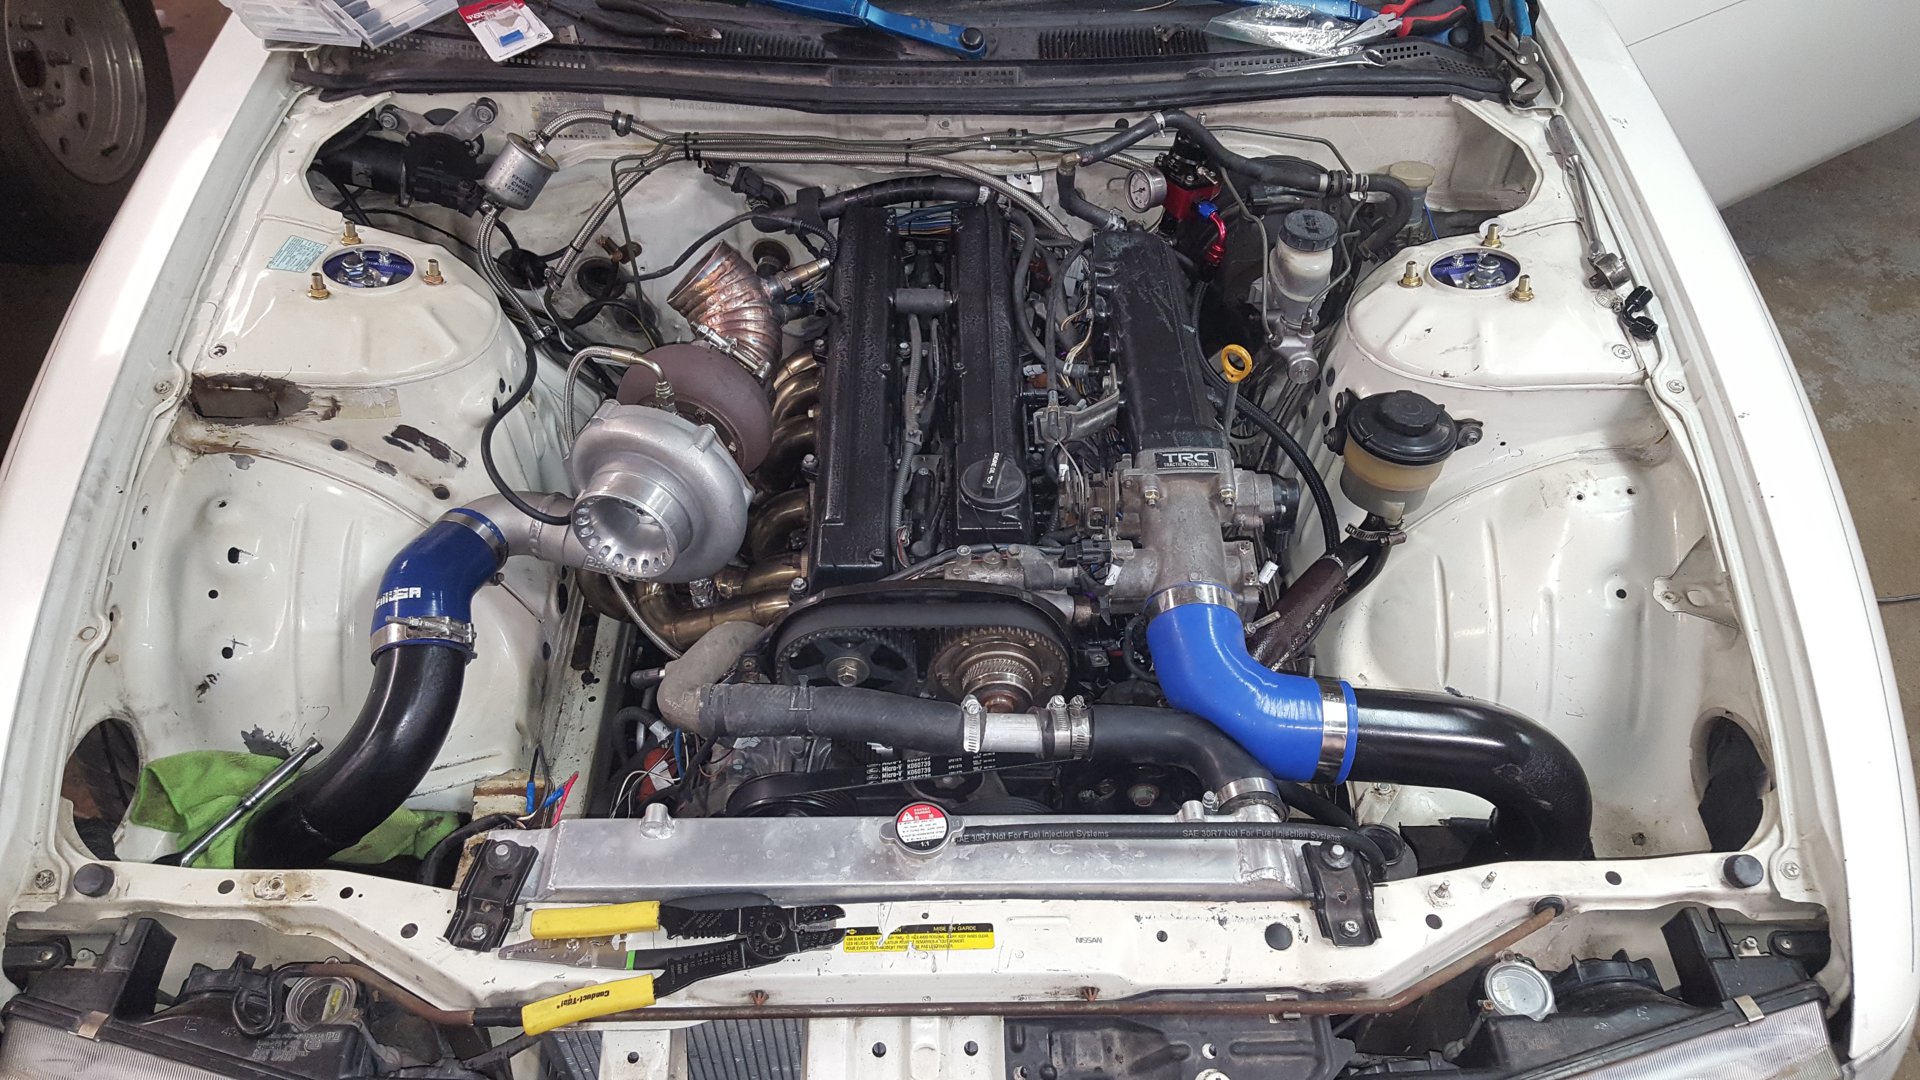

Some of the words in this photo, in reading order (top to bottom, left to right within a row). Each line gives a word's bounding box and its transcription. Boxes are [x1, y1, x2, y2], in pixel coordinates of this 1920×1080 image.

[1162, 453, 1209, 463] TRC
[882, 763, 902, 773] Micro-V
[882, 770, 902, 779] Micro-V
[971, 832, 990, 842] 30R7
[992, 832, 1006, 840] Not
[1008, 831, 1021, 840] For
[1023, 830, 1041, 839] Fuel
[1042, 829, 1074, 839] Injection
[1075, 829, 1109, 839] Systems
[1182, 829, 1199, 837] SAE
[1201, 829, 1222, 837] 30R7
[1224, 829, 1238, 837] Not
[1240, 829, 1253, 837] For
[1256, 829, 1274, 838] Fuel
[1275, 829, 1308, 838] Injection
[1310, 830, 1341, 842] Systems
[1075, 936, 1103, 944] NISSAN
